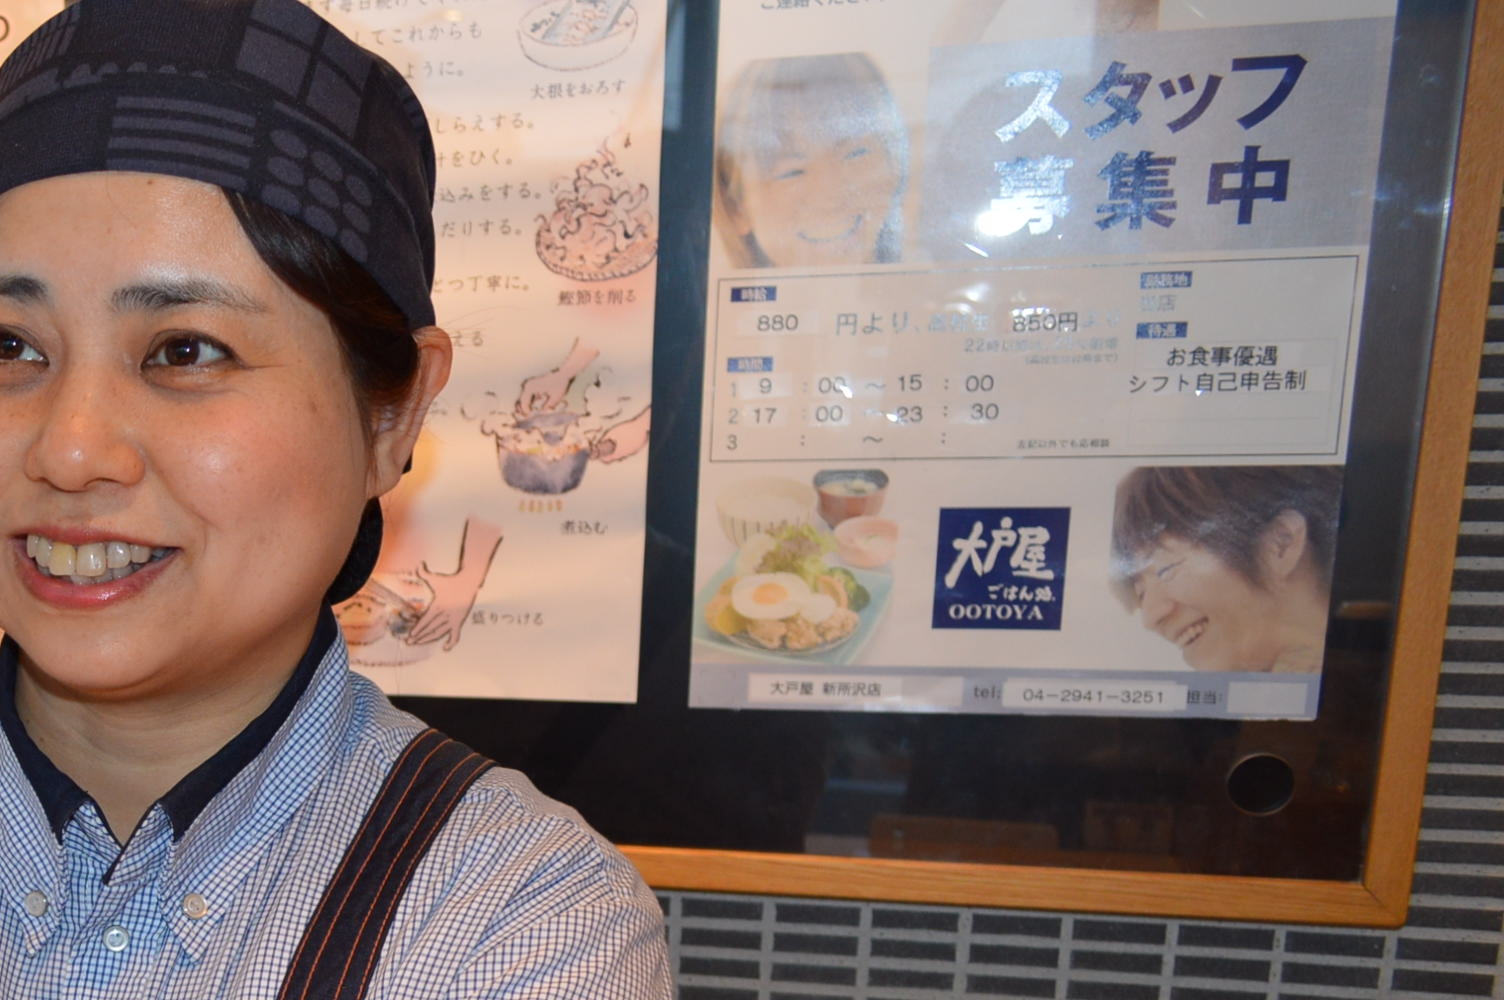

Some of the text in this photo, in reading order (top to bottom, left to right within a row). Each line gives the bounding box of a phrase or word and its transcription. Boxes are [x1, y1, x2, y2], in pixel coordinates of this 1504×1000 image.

[994, 53, 1310, 144] スタッフ
[757, 314, 800, 332] 880
[1166, 345, 1279, 368] お食事優遇
[759, 377, 773, 395] 9
[899, 374, 923, 392] 15
[965, 374, 995, 393] 00
[1129, 368, 1307, 395] シフト自己申告制
[754, 406, 777, 425] 17
[815, 404, 844, 423] 00
[896, 405, 924, 424] 23
[970, 402, 1000, 421] 30
[945, 515, 1055, 589] 大戸屋
[949, 603, 1044, 620] OOTOYA
[769, 680, 814, 696] 大戸屋
[822, 681, 882, 697] 新所沢店
